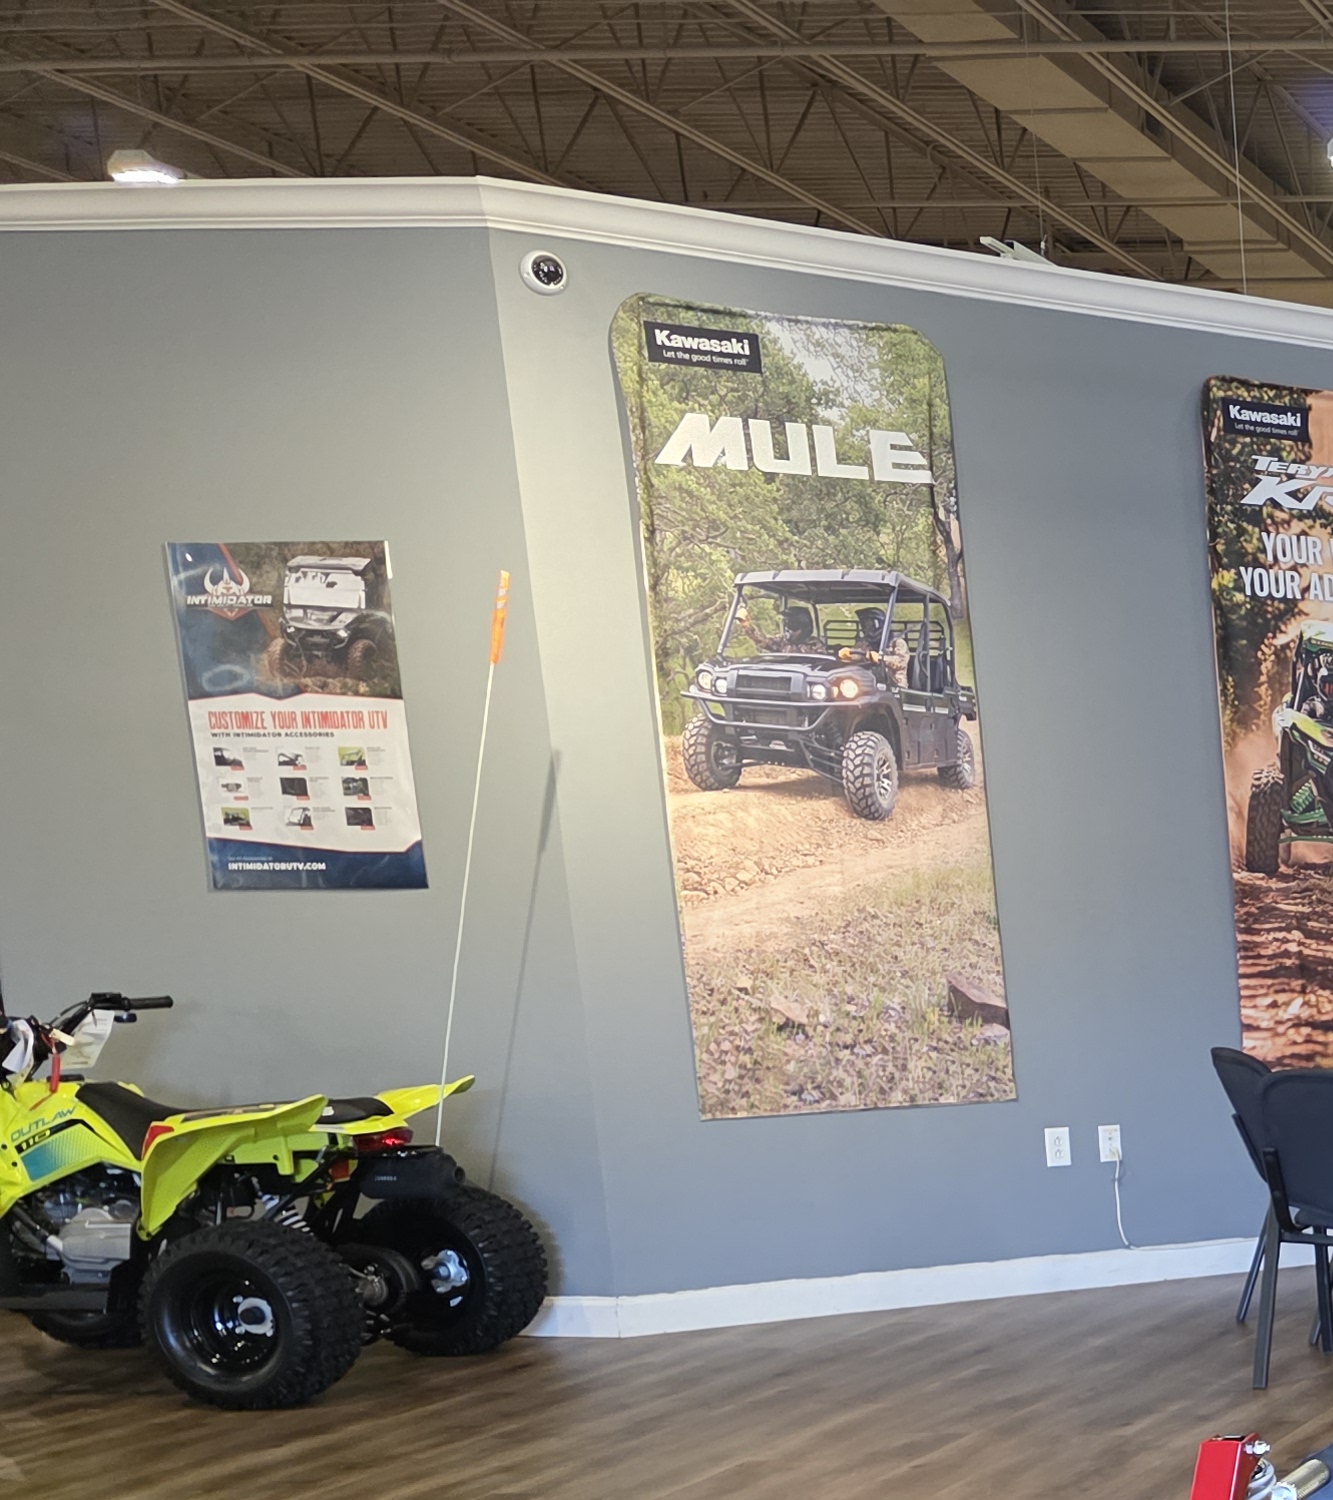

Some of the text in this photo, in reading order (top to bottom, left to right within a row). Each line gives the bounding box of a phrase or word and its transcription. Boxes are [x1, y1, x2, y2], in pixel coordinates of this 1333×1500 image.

[654, 329, 750, 355] Kawasaki
[663, 350, 675, 359] Let
[676, 351, 690, 361] the
[691, 353, 711, 363] good
[712, 356, 733, 365] times
[1229, 405, 1301, 427] Kawasaki
[655, 413, 935, 485] MULE
[1261, 531, 1323, 566] YOUR
[1239, 566, 1302, 600] YOUR
[187, 594, 272, 605] INTIMIDATOR
[208, 711, 388, 730] CUSTOMIZE YOUR INTIMIDATOR UTV
[228, 862, 326, 871] INTIMIDATORUTV.COM
[10, 1104, 78, 1142] OUTLAW
[20, 1128, 51, 1151] 110
